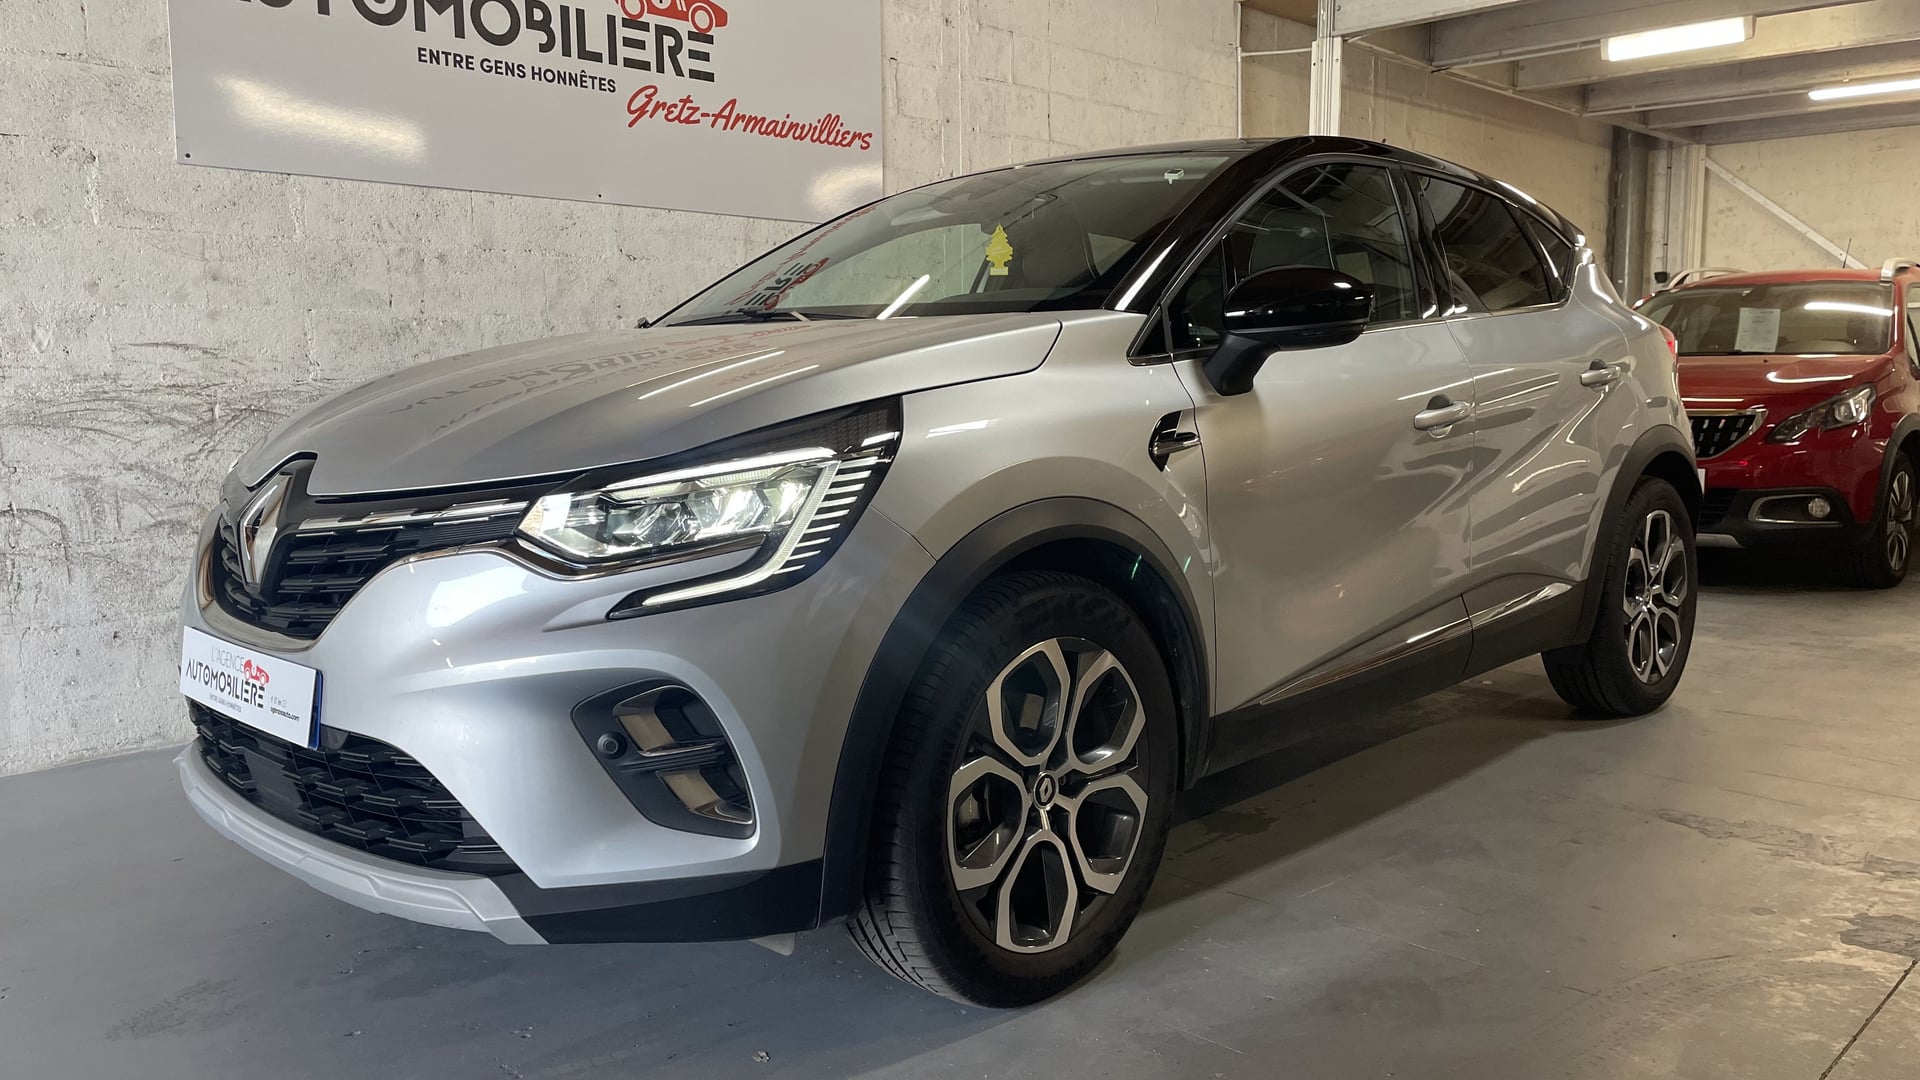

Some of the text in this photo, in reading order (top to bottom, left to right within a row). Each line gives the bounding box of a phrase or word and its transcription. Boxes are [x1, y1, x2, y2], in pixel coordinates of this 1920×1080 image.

[417, 47, 617, 94] ENTRE GENS HONNÊTES
[626, 84, 873, 151] Gretz-Armainvilliers
[211, 645, 245, 673] L'AGENCE
